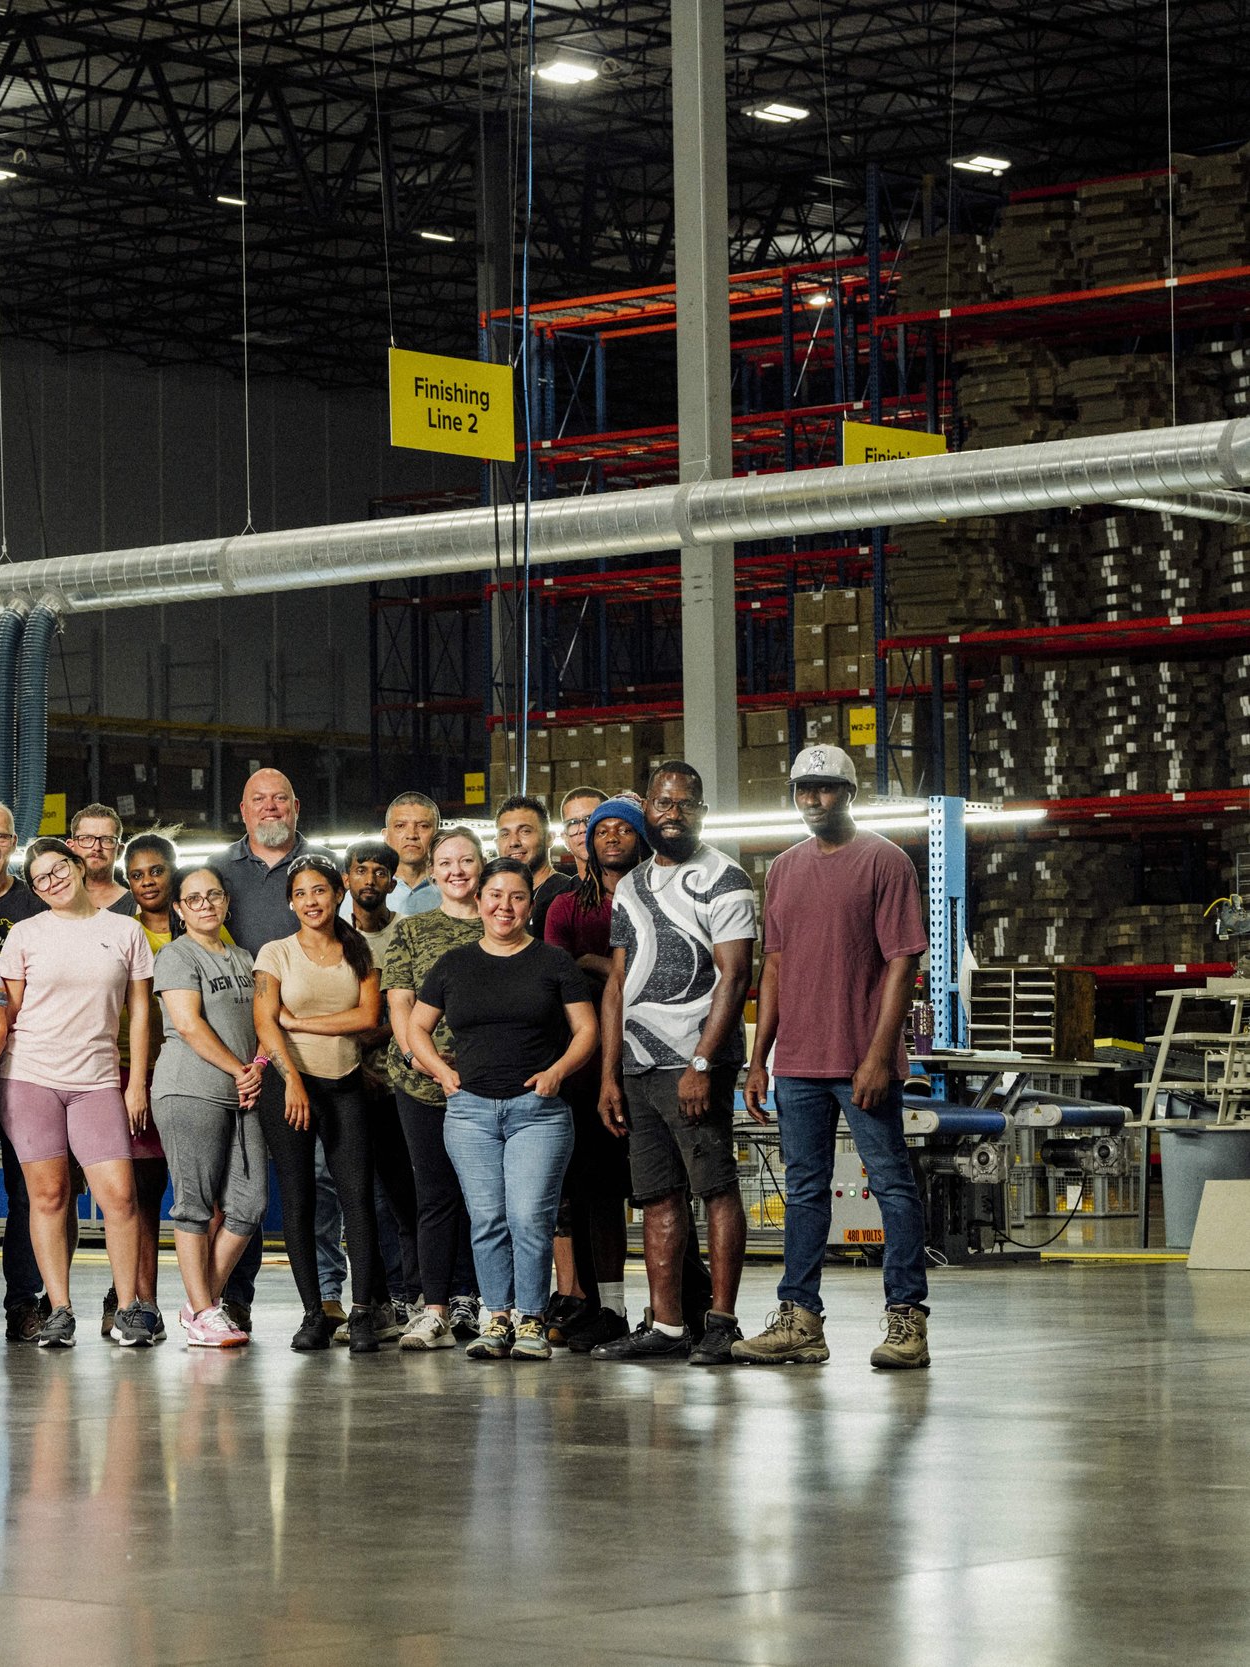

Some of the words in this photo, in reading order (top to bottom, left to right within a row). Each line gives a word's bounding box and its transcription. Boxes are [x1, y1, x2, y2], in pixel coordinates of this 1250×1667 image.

[414, 376, 490, 412] Finishing
[427, 407, 463, 432] Line
[467, 412, 479, 434] 2
[851, 723, 876, 731] W2-27
[209, 975, 233, 994] NEW
[847, 1229, 860, 1242] 480
[862, 1229, 882, 1242] VOLTS
